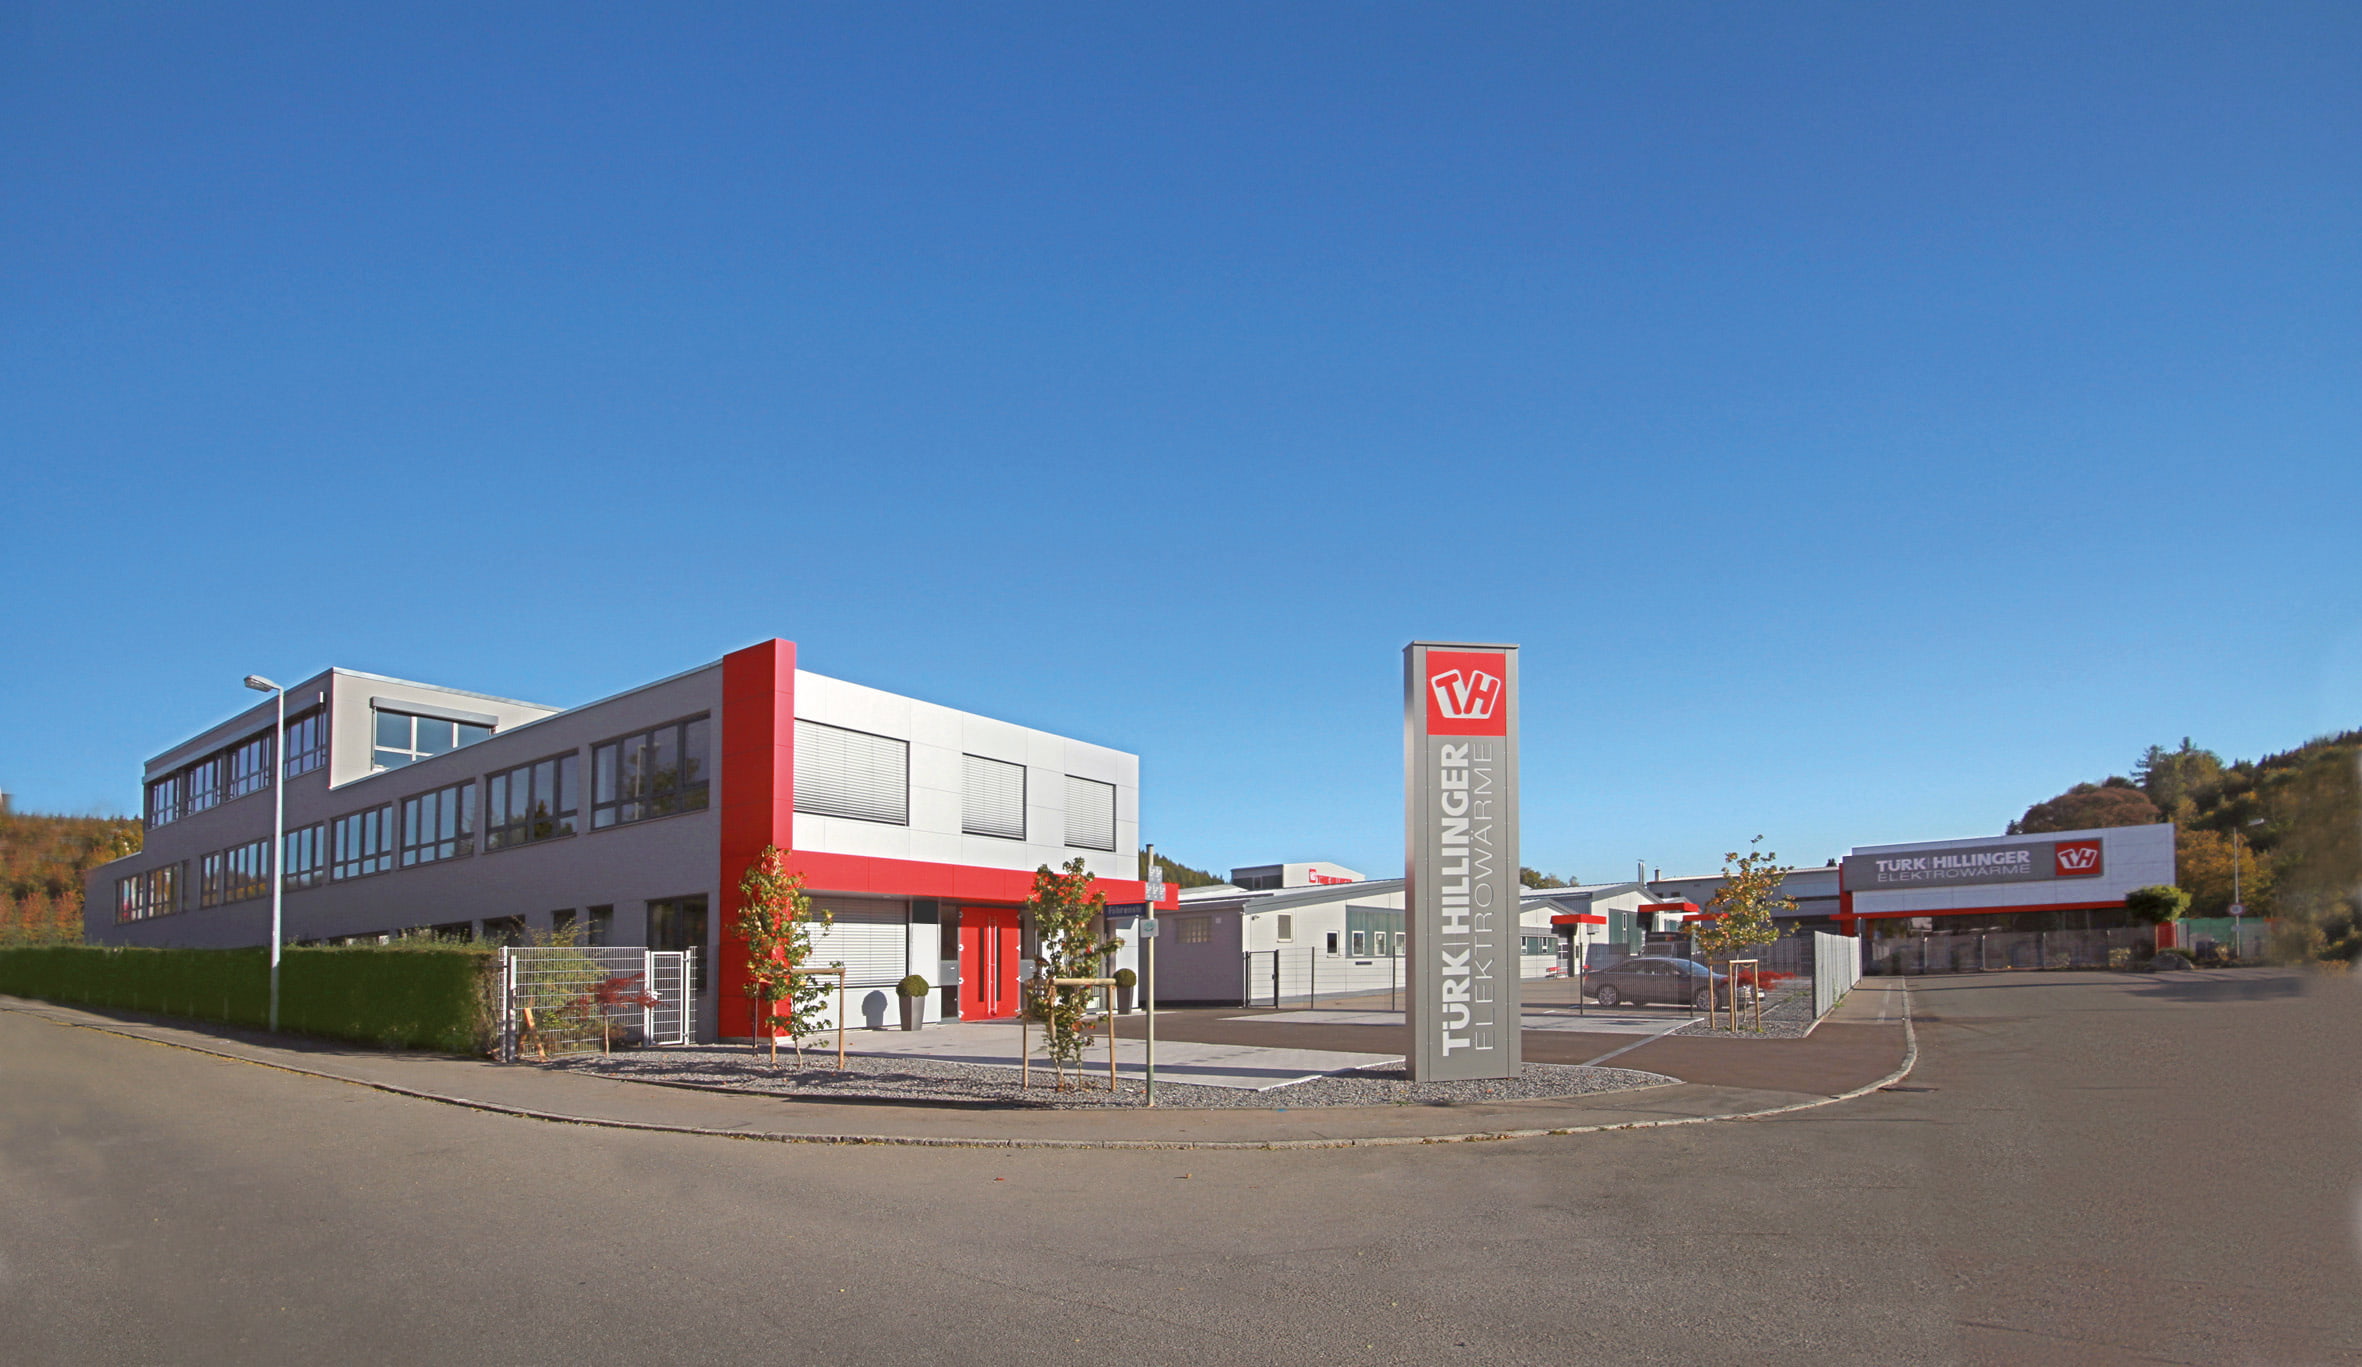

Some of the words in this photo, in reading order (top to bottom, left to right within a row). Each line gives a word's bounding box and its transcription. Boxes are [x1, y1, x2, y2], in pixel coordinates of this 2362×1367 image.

[1441, 742, 1471, 935] HILLINGER
[1470, 743, 1495, 1051] ELEKTROWÄRME
[1932, 850, 2031, 869] HILLINGER
[1441, 948, 1471, 1057] TÜRK
